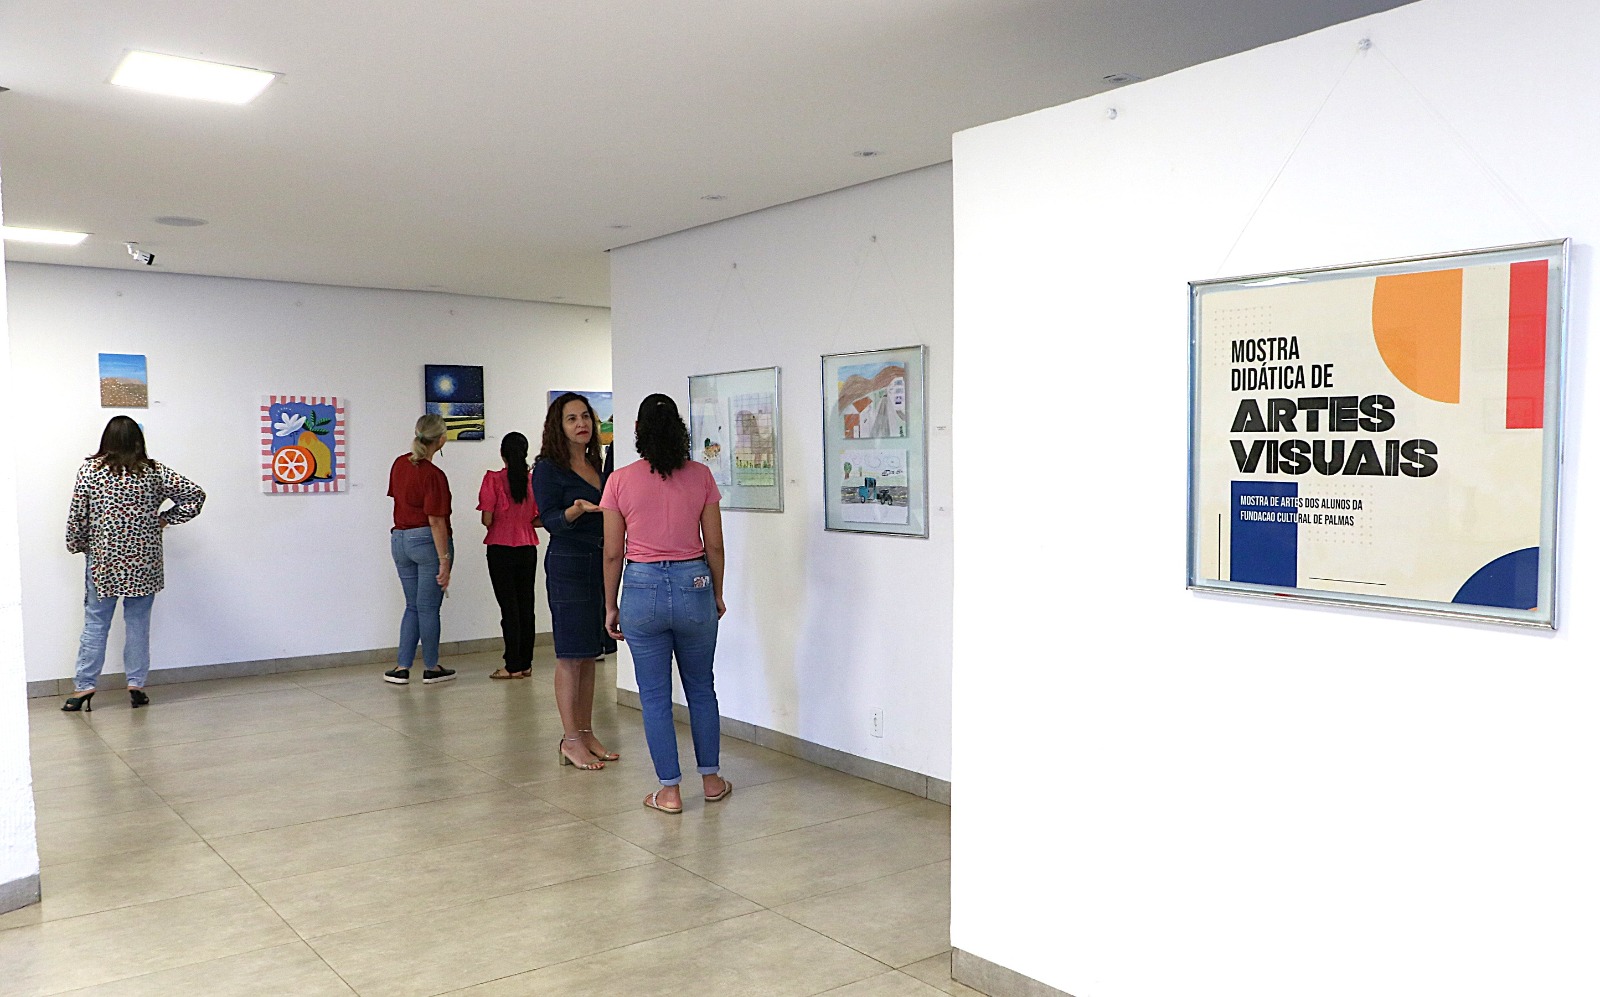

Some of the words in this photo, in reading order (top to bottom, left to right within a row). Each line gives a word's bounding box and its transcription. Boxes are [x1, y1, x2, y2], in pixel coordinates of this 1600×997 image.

[1231, 336, 1300, 363] MOSTRA
[1231, 362, 1306, 391] DIDÁTICA
[1311, 363, 1334, 389] DE
[1230, 394, 1395, 432] ARTES
[1230, 438, 1438, 477] VISUAIS
[1240, 495, 1269, 507] MOSTRA
[1270, 496, 1279, 507] DE
[1280, 496, 1304, 508] ARTES
[1305, 498, 1320, 509] DOS
[1321, 498, 1351, 510] ALUNOS
[1352, 499, 1363, 511] DA
[1240, 510, 1276, 522] FUNDACAO
[1276, 512, 1311, 524] CULTURAL
[1313, 514, 1323, 525] DE
[1324, 514, 1355, 526] PALMAS
